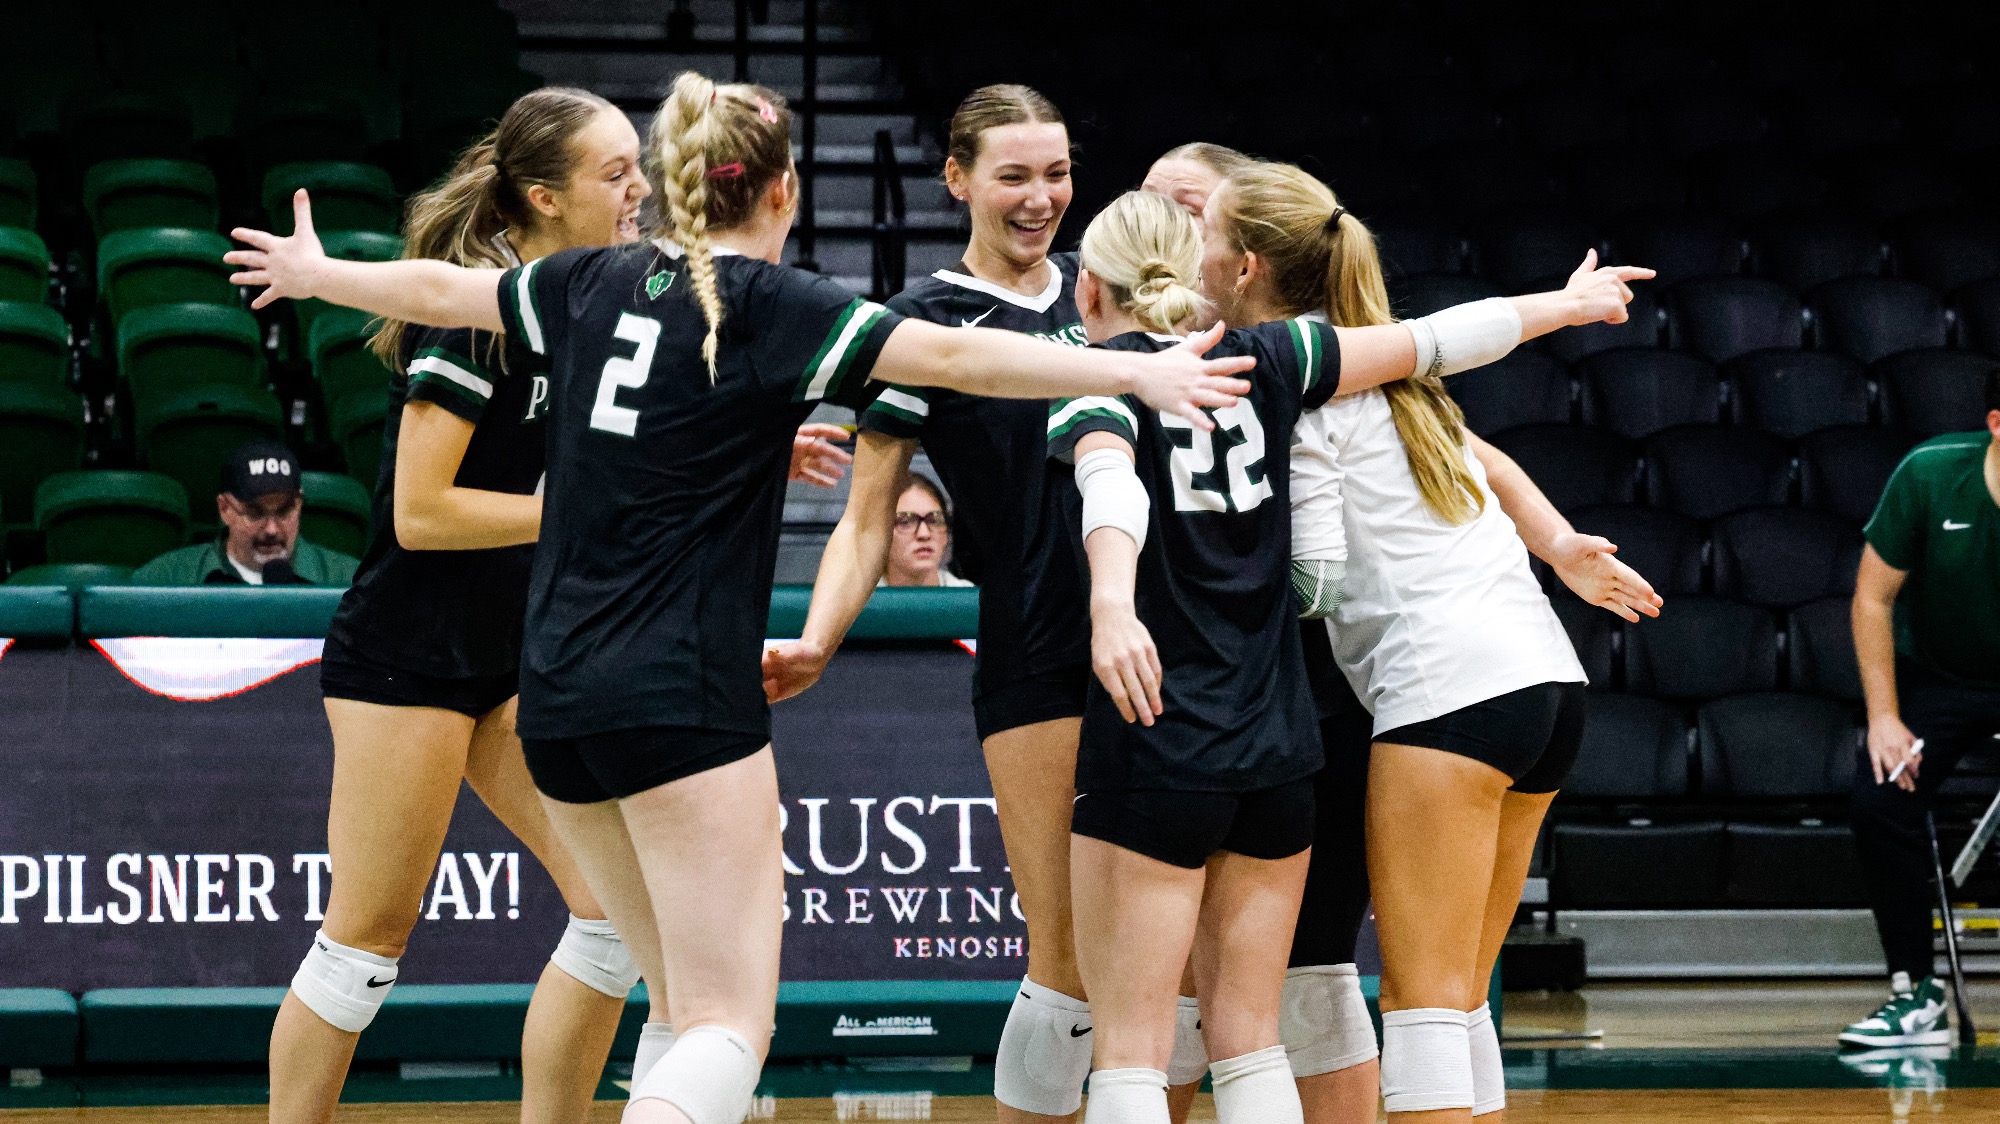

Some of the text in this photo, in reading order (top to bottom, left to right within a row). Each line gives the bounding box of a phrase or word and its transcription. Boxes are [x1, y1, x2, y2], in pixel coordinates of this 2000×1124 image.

[590, 312, 662, 437] 2
[1160, 397, 1273, 512] 22
[779, 796, 1012, 875] UST
[0, 852, 520, 925] PILSNER TAY!
[893, 936, 1030, 958] KENOSH
